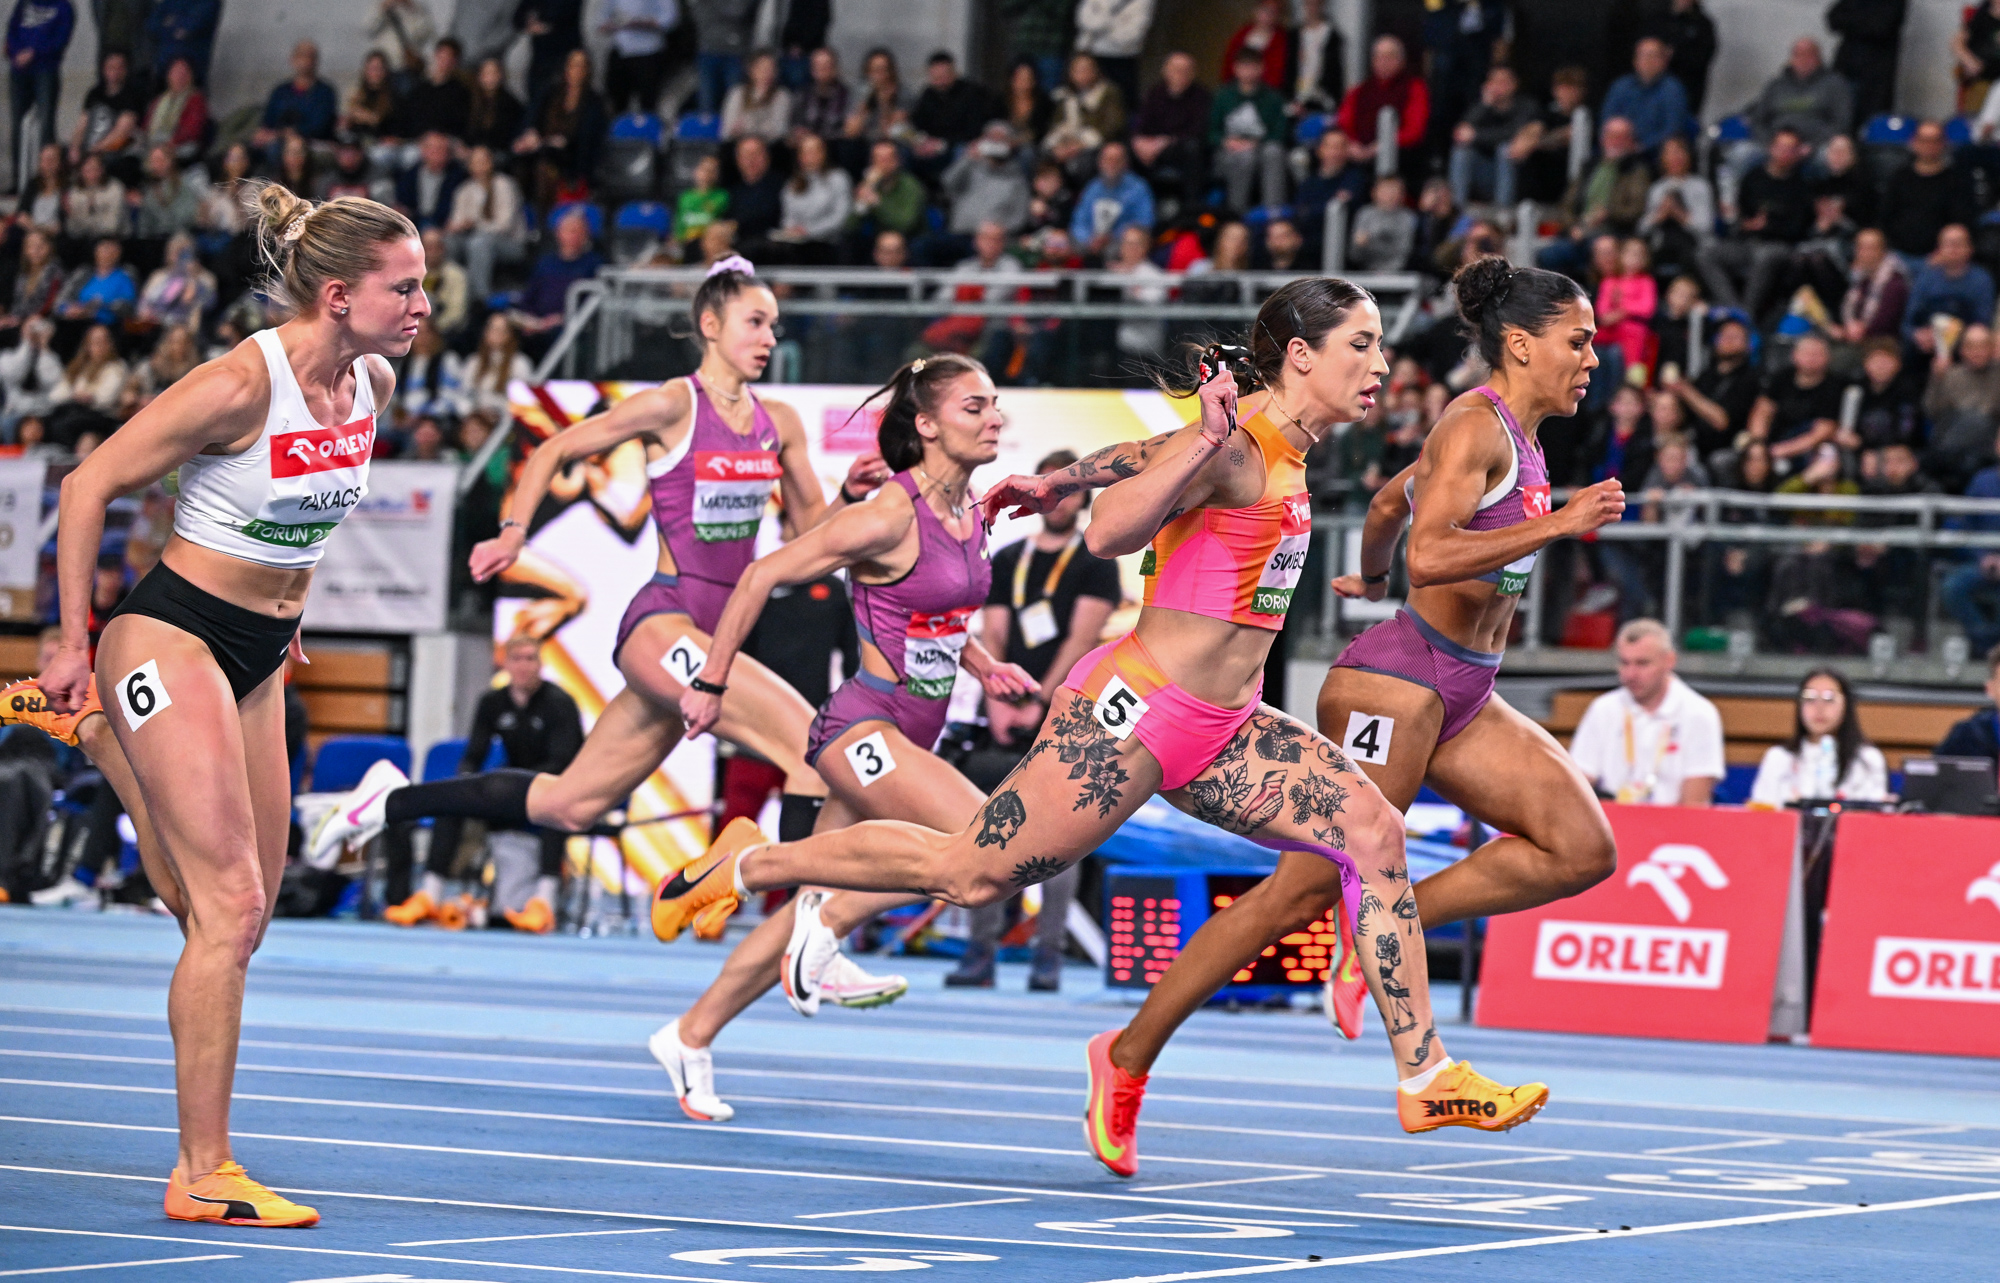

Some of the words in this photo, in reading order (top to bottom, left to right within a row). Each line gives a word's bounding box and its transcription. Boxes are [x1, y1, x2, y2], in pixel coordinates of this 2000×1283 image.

[319, 431, 370, 458] ORLEN
[299, 486, 361, 511] TAKACS
[252, 522, 307, 543] TORUŃ
[672, 647, 701, 677] 2
[126, 672, 156, 716] 6
[1103, 687, 1138, 727] 5
[1352, 719, 1380, 759] 4
[856, 742, 883, 775] 3
[1549, 932, 1712, 977] ORLEN
[1419, 1098, 1498, 1118] NITRO
[1035, 1213, 1358, 1238] 5
[669, 1246, 1002, 1271] 6
